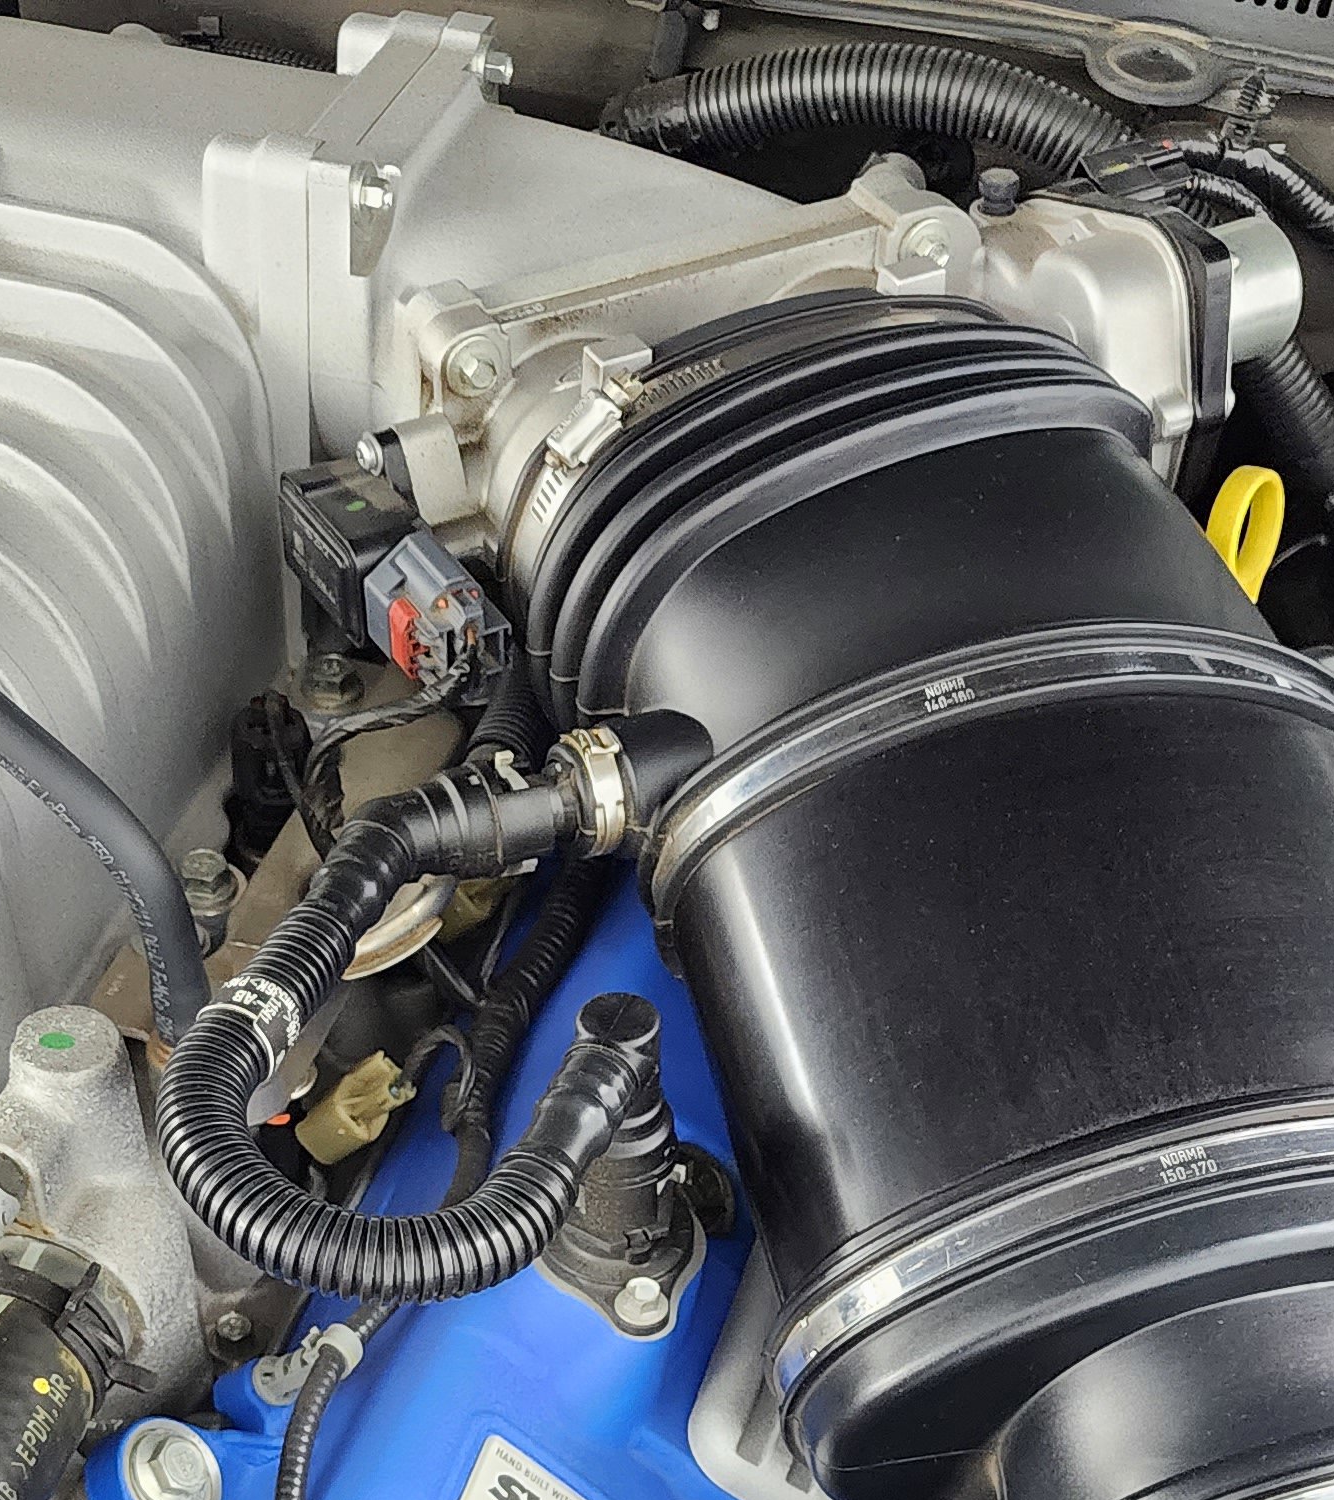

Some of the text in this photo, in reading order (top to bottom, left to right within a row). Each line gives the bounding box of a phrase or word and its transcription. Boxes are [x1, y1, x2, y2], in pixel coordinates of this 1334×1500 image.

[1159, 1146, 1207, 1169] NORMA
[1159, 1159, 1218, 1185] 150-170
[496, 1447, 523, 1471] HAND
